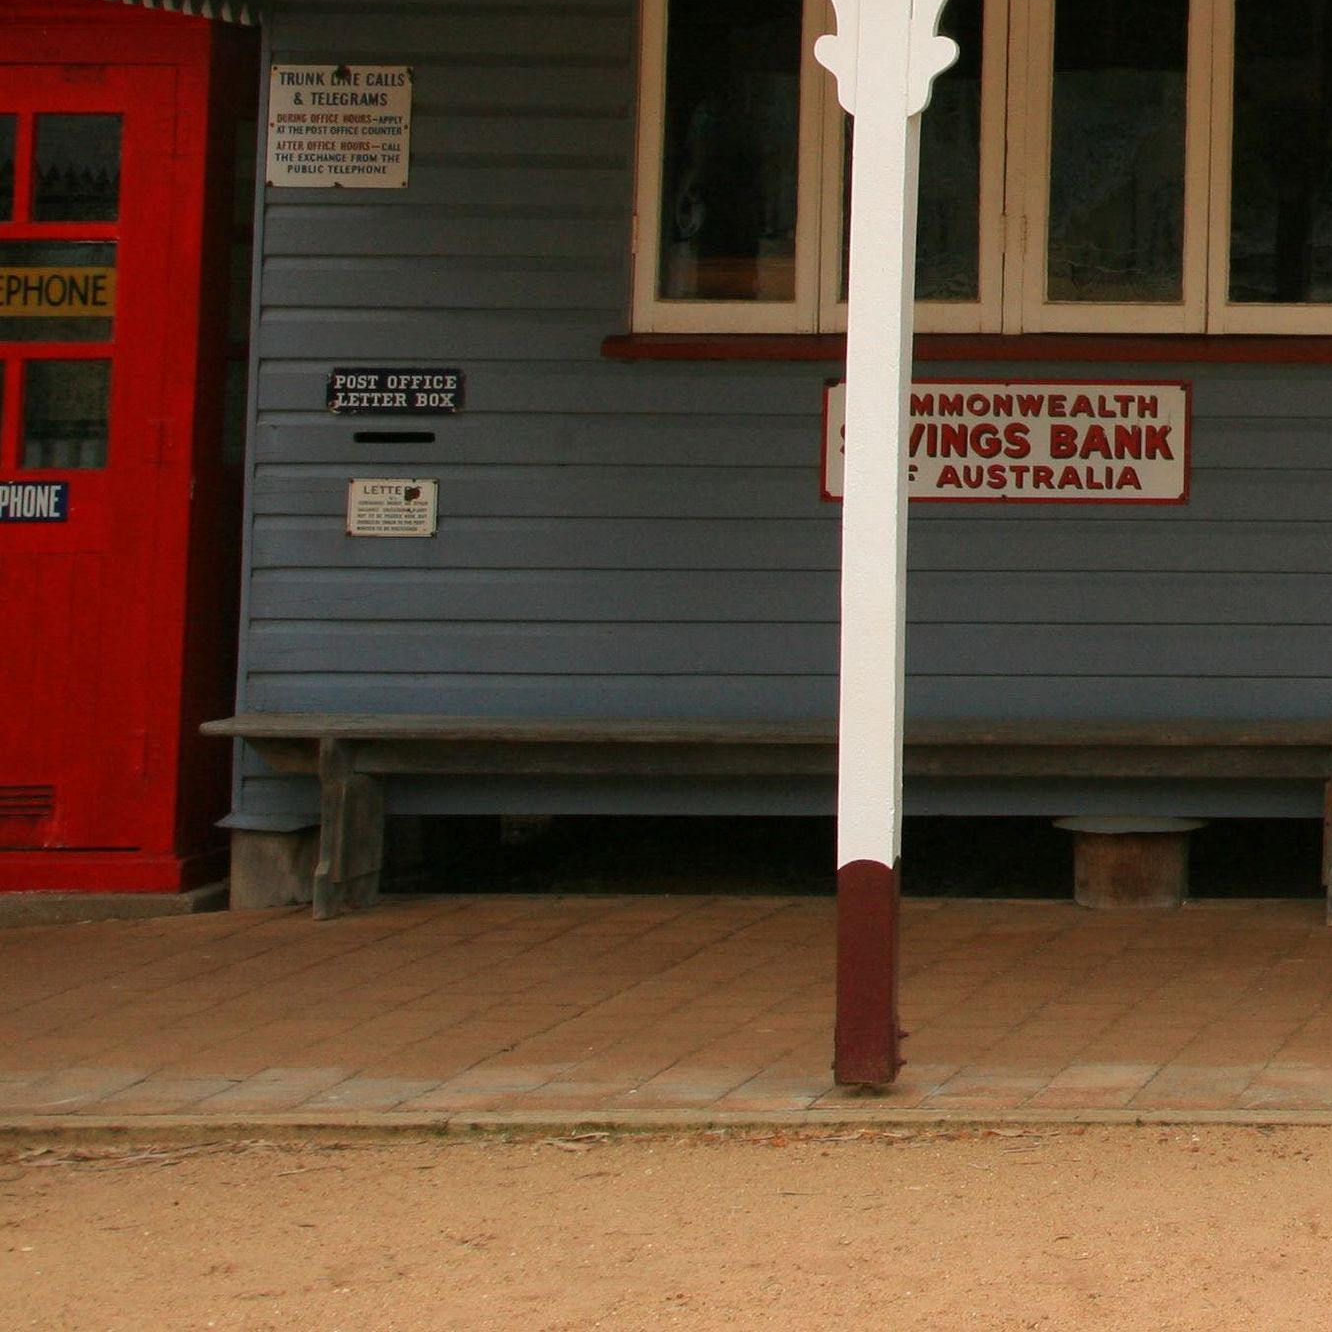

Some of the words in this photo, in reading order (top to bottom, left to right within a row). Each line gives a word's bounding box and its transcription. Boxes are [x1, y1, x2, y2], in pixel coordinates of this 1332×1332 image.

[280, 72, 325, 86] TRUNK
[366, 73, 405, 87] CALLS
[294, 92, 303, 106] &
[311, 92, 388, 106] TELEGRAMS
[277, 114, 307, 124] DURING
[311, 114, 339, 124] OFFICE
[277, 127, 288, 135] AT
[289, 127, 304, 135] THE
[305, 127, 327, 135] POST
[330, 127, 359, 136] OFFICE
[362, 128, 402, 136] COUNTER
[277, 141, 304, 151] AFTER
[307, 141, 336, 151] OFFICE
[381, 143, 401, 152] CALL
[275, 153, 294, 162] THE
[298, 153, 347, 162] EXCHANGE
[351, 154, 377, 163] FROM
[381, 154, 400, 163] THE
[287, 165, 325, 174] PUBLIC
[328, 165, 387, 174] TELEPHONE
[334, 375, 379, 389] POST
[387, 375, 457, 389] OFFICE
[336, 392, 407, 407] LETTER
[415, 393, 455, 407] BOX
[1049, 423, 1174, 460] BANK
[936, 465, 1142, 490] AUSTRALIA
